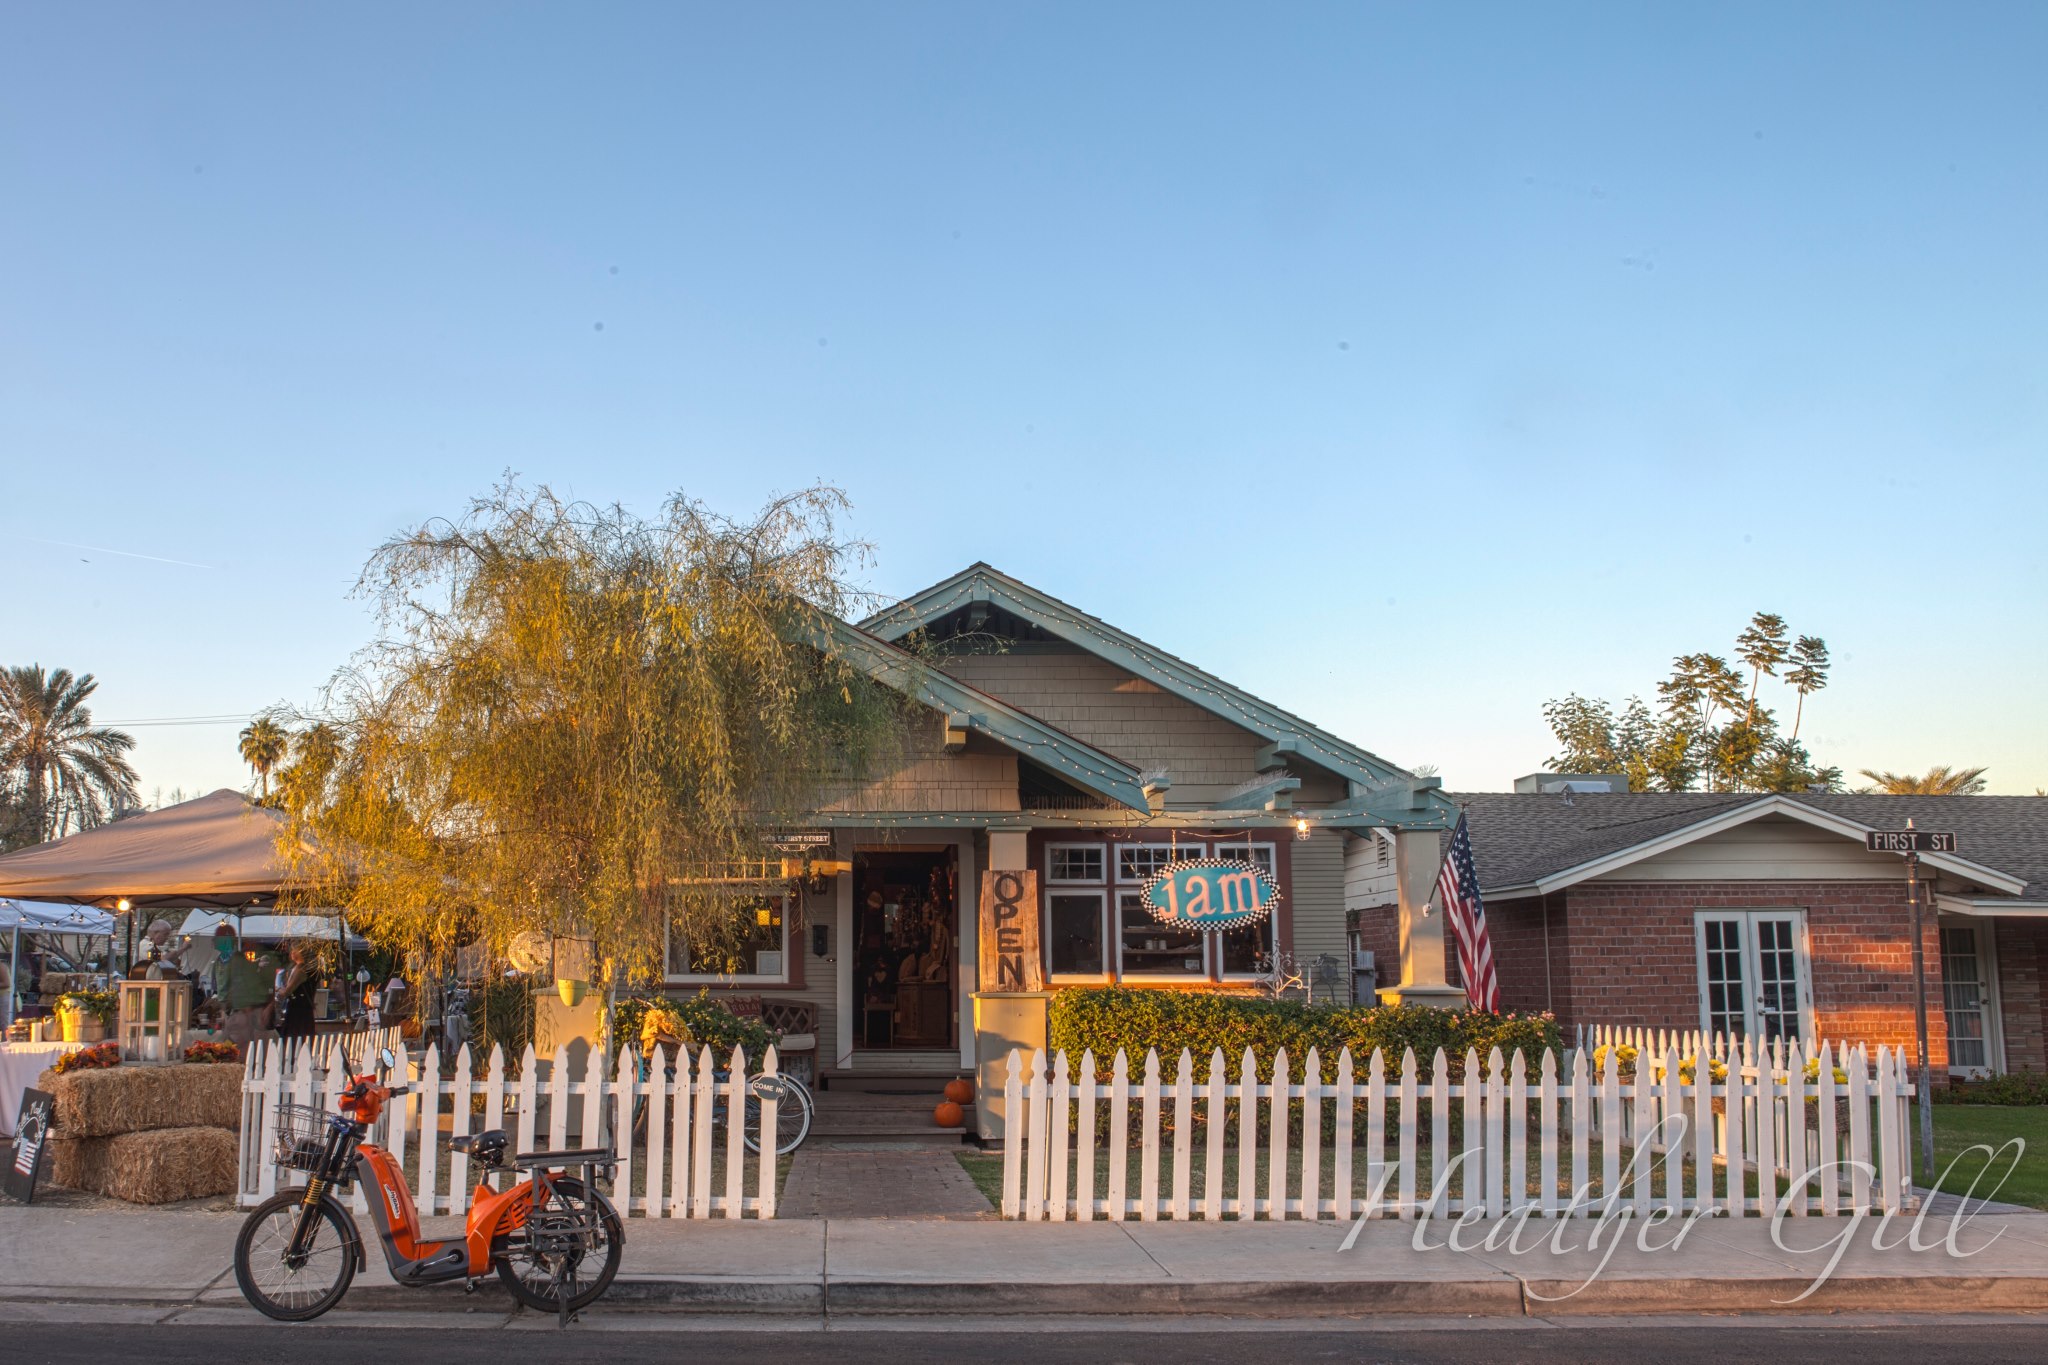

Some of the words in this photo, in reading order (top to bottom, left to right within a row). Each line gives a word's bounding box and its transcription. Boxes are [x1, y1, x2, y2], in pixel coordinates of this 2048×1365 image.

[1874, 833, 1918, 850] FIRST
[1931, 834, 1949, 851] ST
[1158, 871, 1263, 919] jam
[994, 873, 1024, 986] OPEN
[754, 1082, 774, 1091] COME
